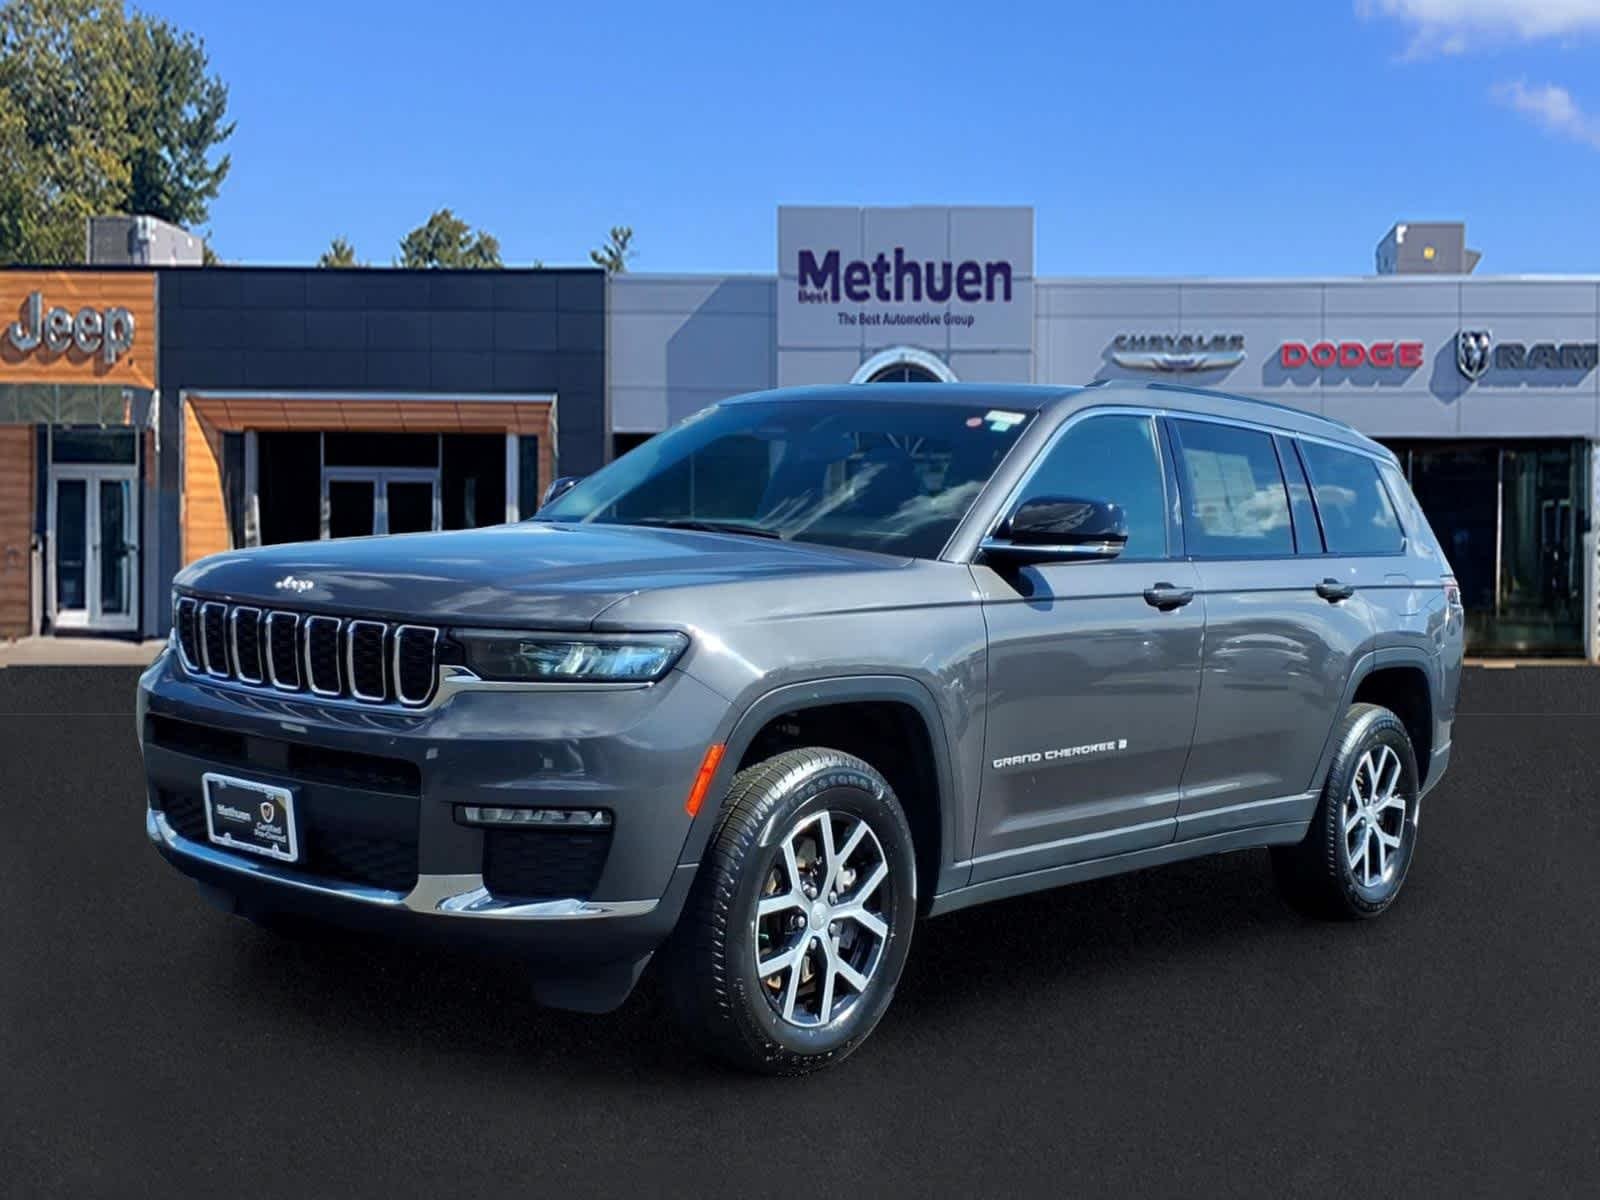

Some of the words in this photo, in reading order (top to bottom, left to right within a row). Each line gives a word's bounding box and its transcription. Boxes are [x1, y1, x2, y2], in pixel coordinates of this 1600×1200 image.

[798, 247, 1012, 303] Methuen
[10, 290, 135, 364] Jeep
[838, 312, 857, 326] The
[859, 312, 881, 326] Best
[883, 312, 941, 326] Automotive
[944, 312, 975, 329] Group
[1113, 334, 1245, 354] CHRYSLER
[1281, 341, 1425, 368] DODGE
[1495, 343, 1599, 370] RAM
[992, 752, 1042, 769] GRAND
[1044, 740, 1117, 760] CHEROKEE
